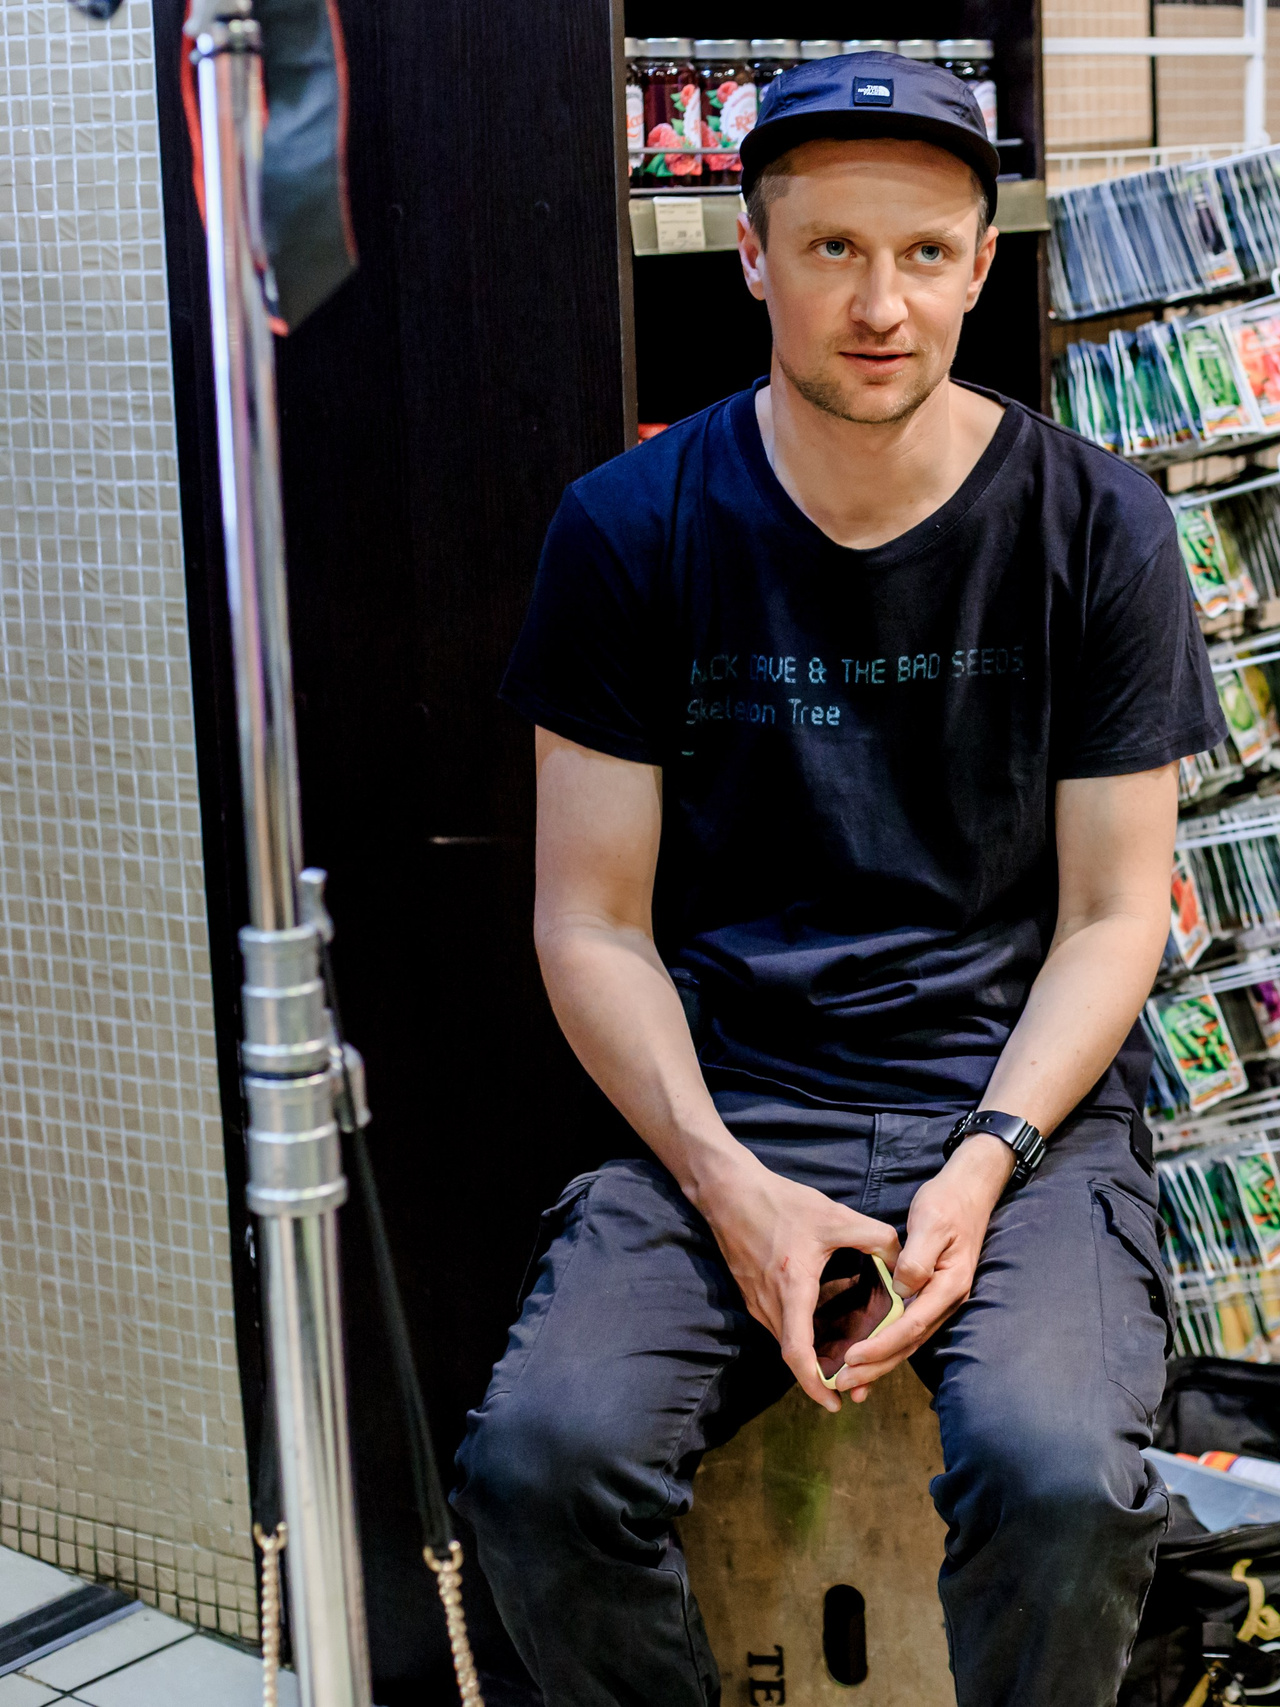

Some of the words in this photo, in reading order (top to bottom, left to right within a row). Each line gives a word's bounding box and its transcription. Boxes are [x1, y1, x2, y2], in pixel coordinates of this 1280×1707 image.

[808, 656, 828, 684] &
[841, 658, 886, 684] THE
[897, 652, 941, 683] BAD
[951, 645, 1025, 678] SEEDS
[685, 696, 776, 725] Skeleon
[788, 698, 841, 725] Tree
[747, 1644, 786, 1707] TE
